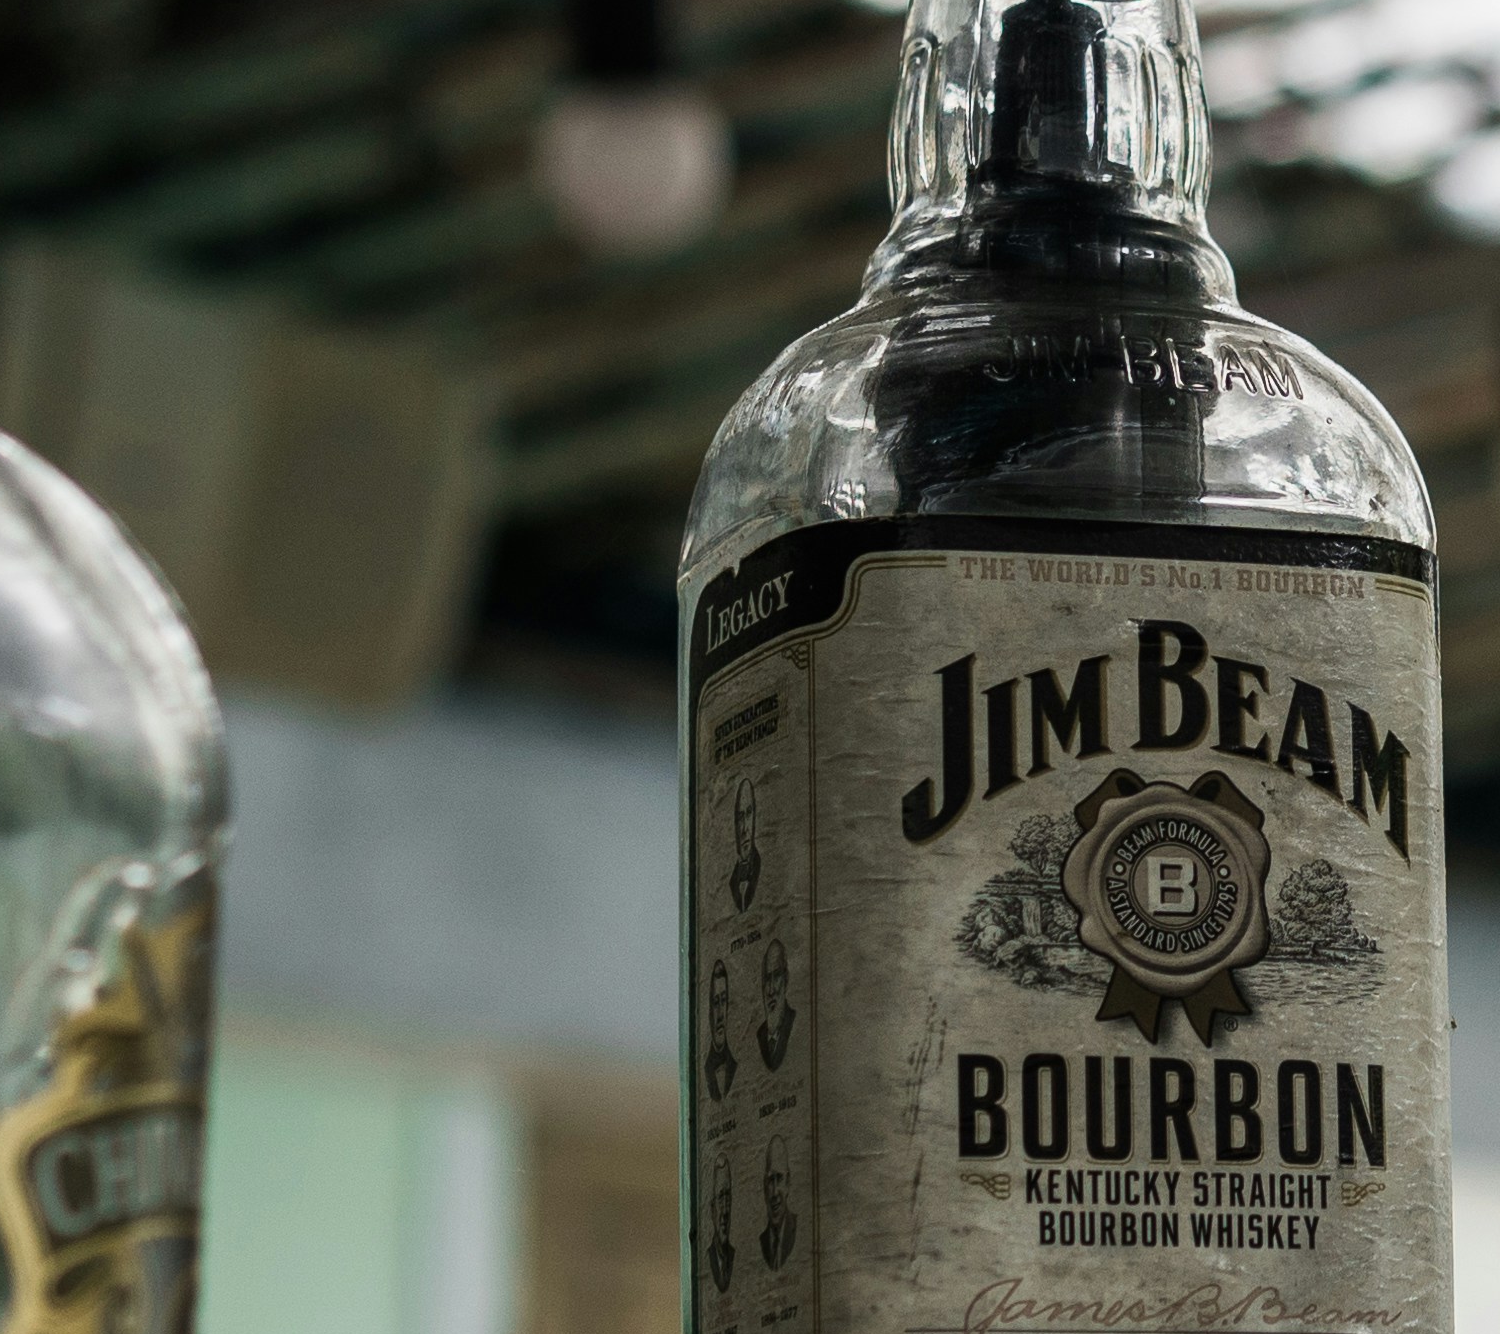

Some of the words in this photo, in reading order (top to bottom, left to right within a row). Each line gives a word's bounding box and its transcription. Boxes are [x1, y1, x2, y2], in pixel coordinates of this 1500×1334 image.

[1119, 334, 1305, 401] BEAM
[959, 556, 1016, 581] THE
[1027, 558, 1156, 587] WORLD'S
[1236, 567, 1366, 599] BOURBON
[705, 570, 794, 656] LEGACY
[901, 651, 1115, 846] JIM
[1128, 618, 1411, 869] BEAM
[1116, 825, 1157, 863] BEAM
[1157, 820, 1227, 866] FORMULA
[1109, 892, 1176, 952] STANDARD
[1179, 917, 1223, 951] SINCE
[1213, 881, 1237, 922] 1795
[1147, 856, 1199, 917] B
[957, 1053, 1388, 1171] BOURBON
[1025, 1169, 1180, 1207] KENTUCKY
[1193, 1172, 1331, 1210] STRAIGHT
[1039, 1210, 1179, 1248] BOURBON
[1190, 1213, 1320, 1250] WHISKEY
[1224, 1284, 1402, 1329] Beam
